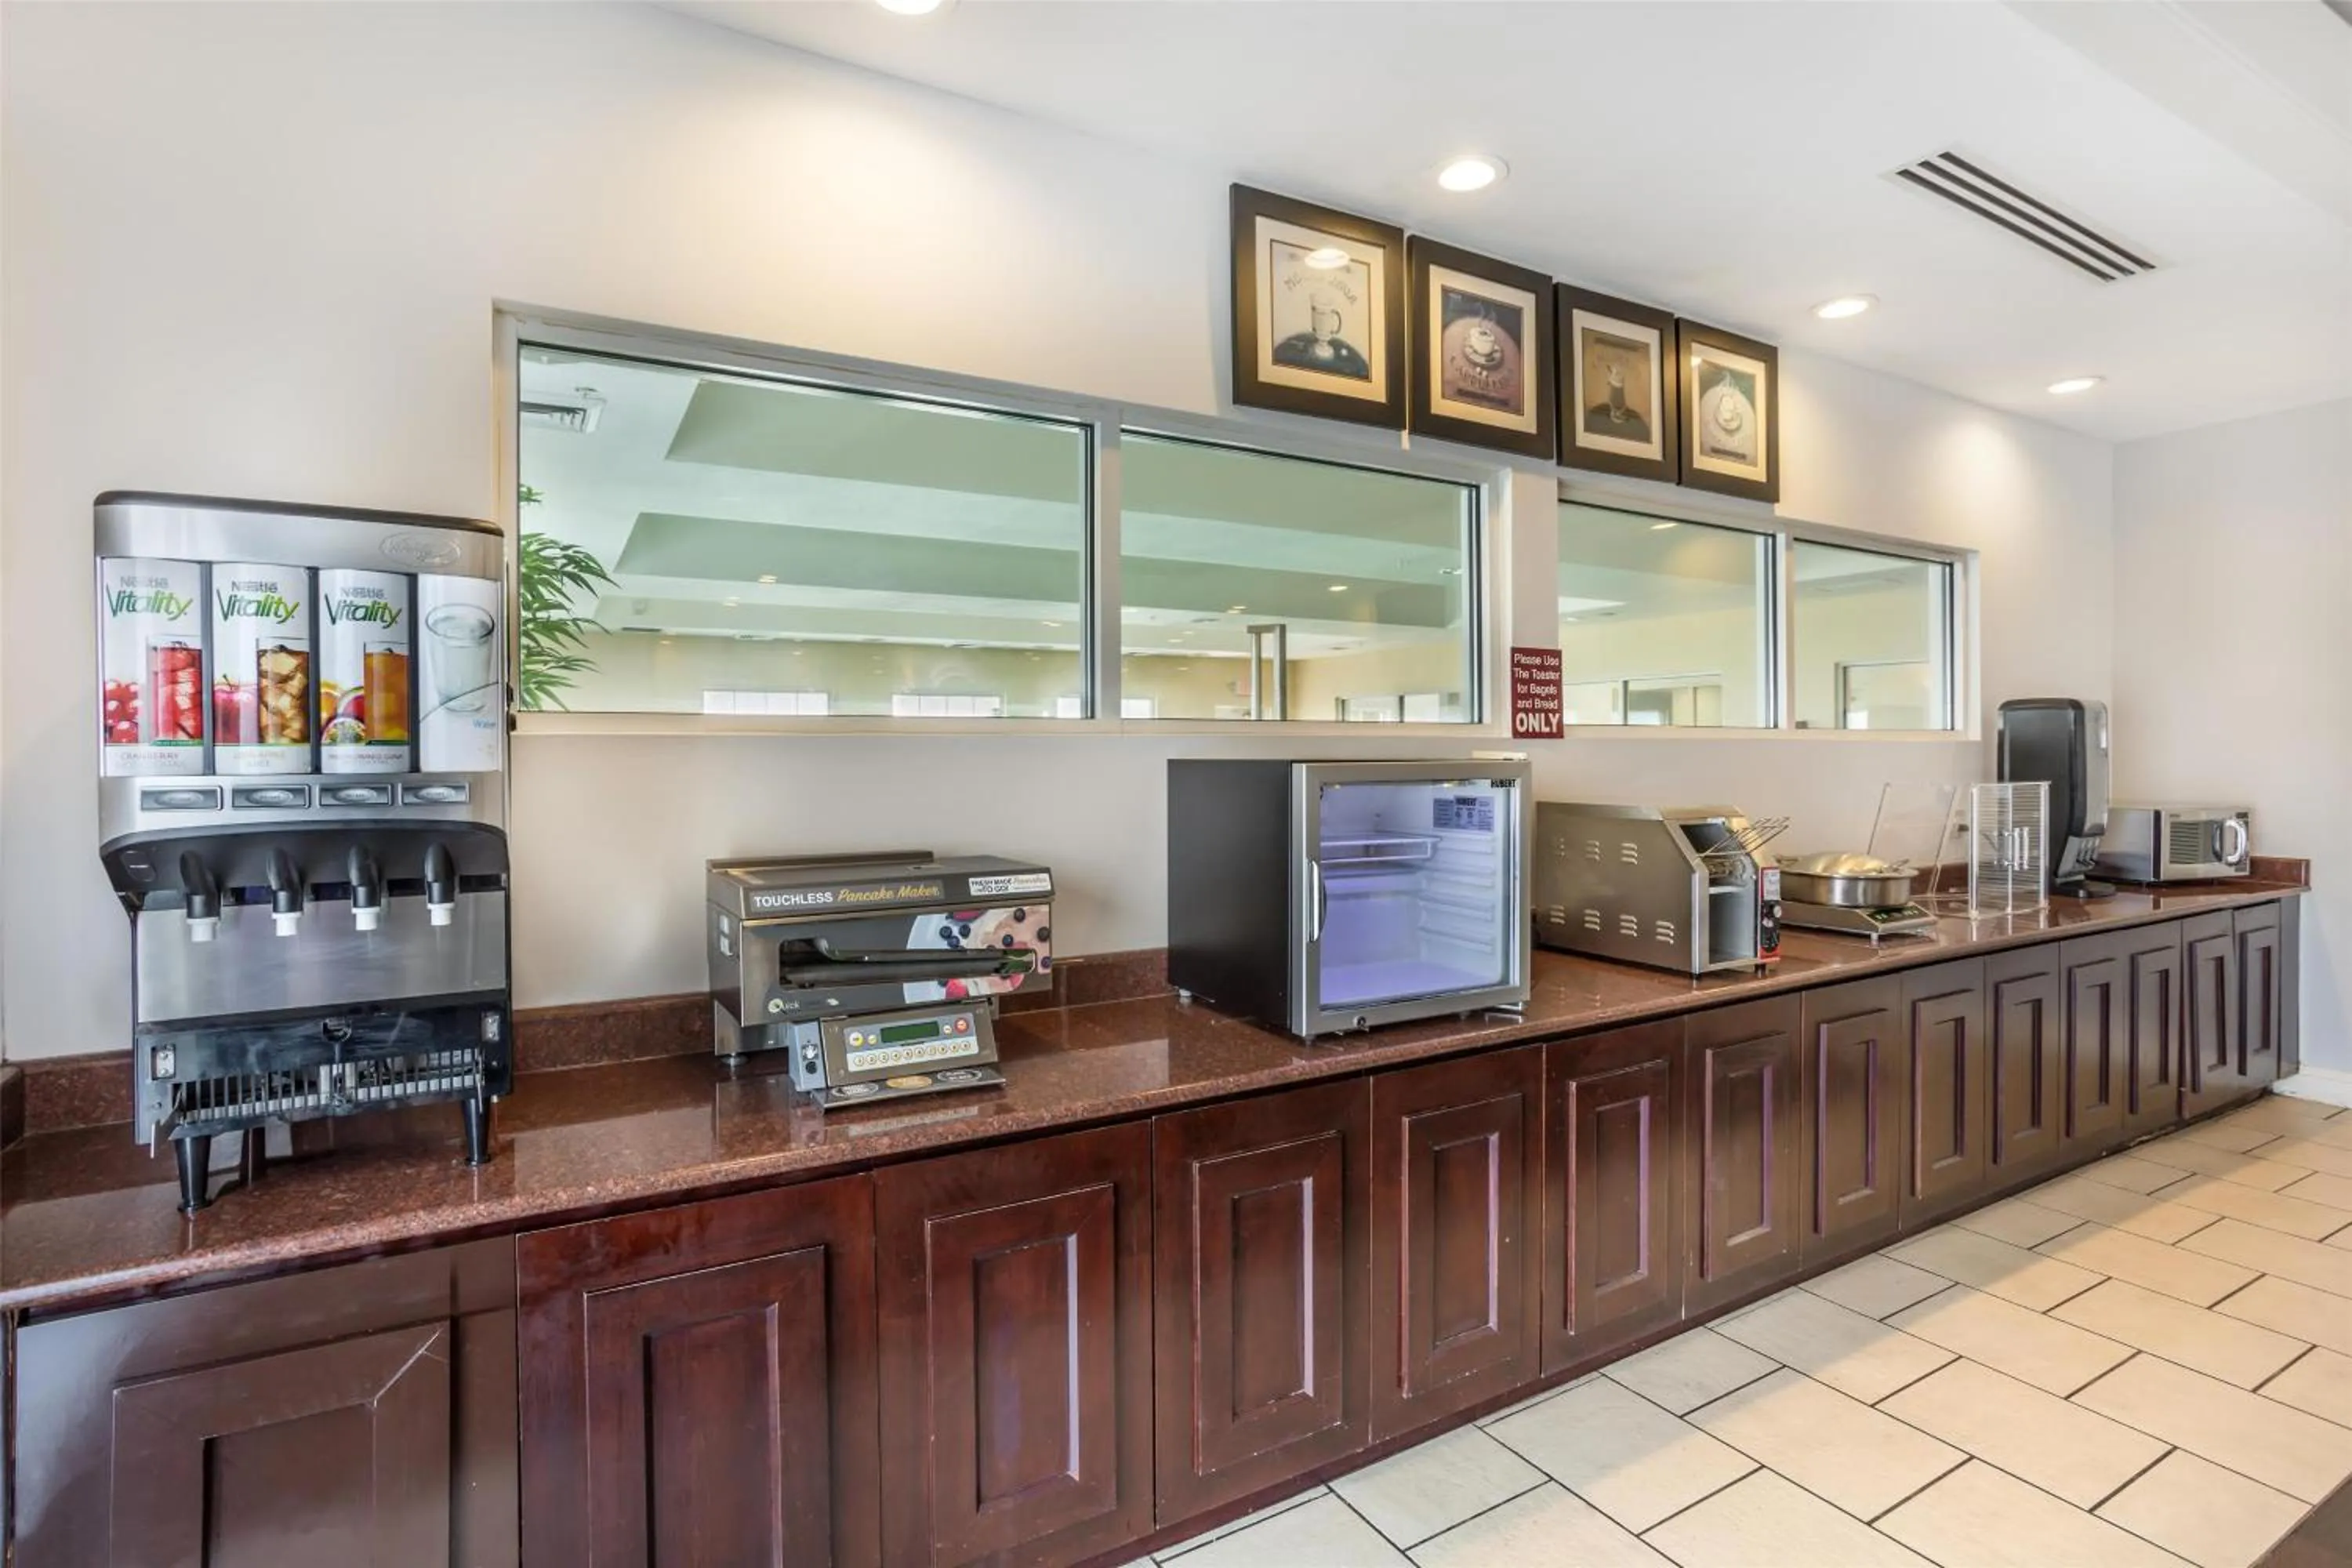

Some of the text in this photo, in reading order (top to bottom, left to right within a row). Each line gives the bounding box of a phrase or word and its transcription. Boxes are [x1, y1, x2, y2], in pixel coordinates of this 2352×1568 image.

[106, 583, 194, 622] Vitality
[216, 588, 300, 625] Vitality
[324, 593, 403, 630] Vitality
[1513, 653, 1559, 666] Please Use
[1513, 667, 1560, 680] The Toaster
[1517, 683, 1558, 697] for Bagels
[1517, 698, 1559, 710] and Bread
[1515, 712, 1560, 733] ONLY
[1490, 778, 1516, 789] HUBERT
[753, 884, 939, 909] TOUCHLESS Pancake Maker
